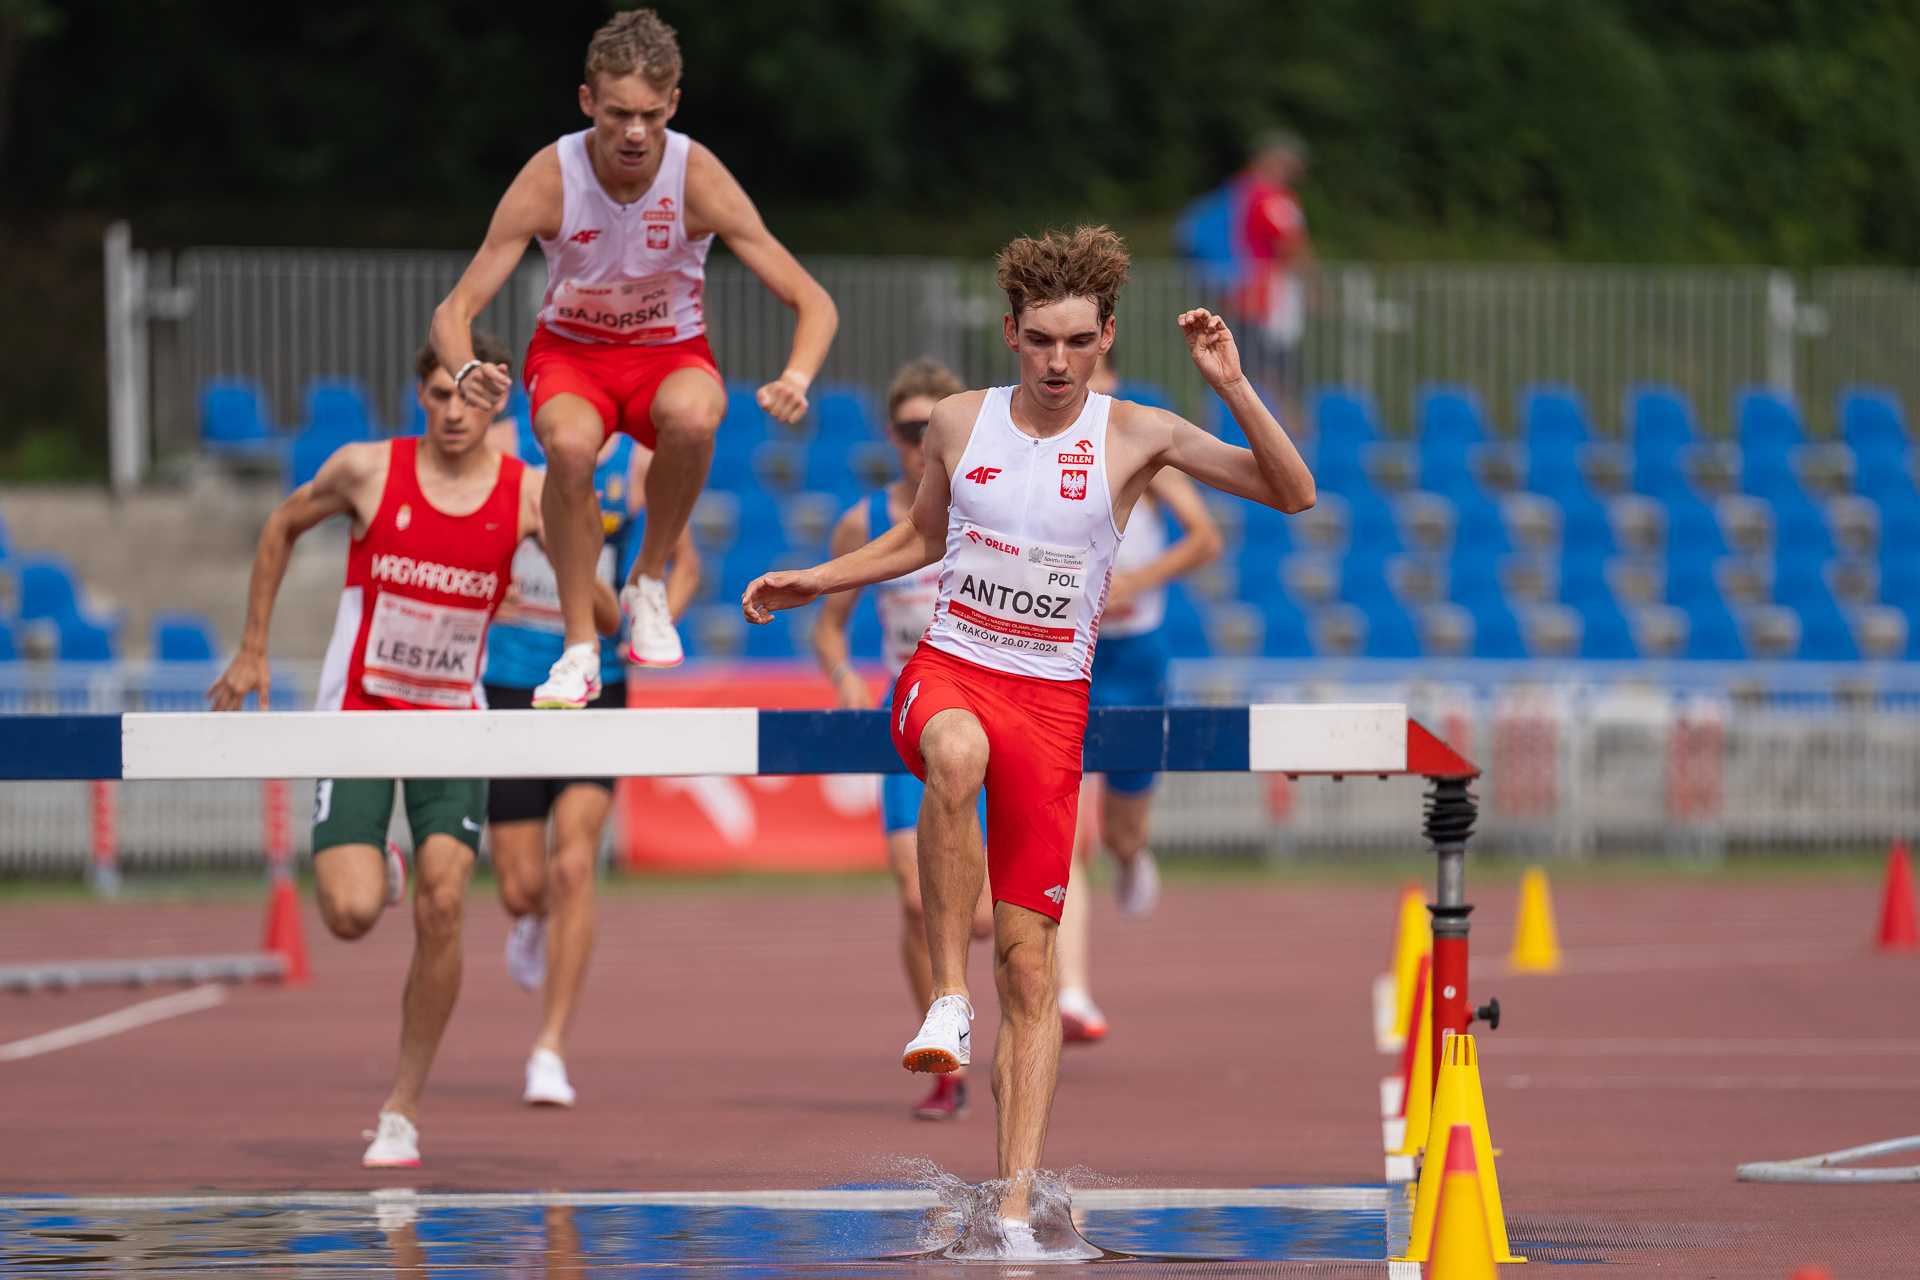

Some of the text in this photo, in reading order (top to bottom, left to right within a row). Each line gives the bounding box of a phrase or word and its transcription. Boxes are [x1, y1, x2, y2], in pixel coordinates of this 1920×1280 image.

[569, 229, 602, 245] 4F
[642, 288, 669, 303] POL
[558, 301, 669, 330] BAJORSKI
[1060, 455, 1093, 464] ORLEN
[965, 466, 1003, 485] 4F
[985, 537, 1020, 557] ORLEN
[1044, 556, 1061, 564] Sportu
[1063, 558, 1083, 566] Turystyki
[371, 553, 499, 602] MAGYARORSZÁ
[1048, 572, 1080, 589] POL
[959, 574, 1072, 620] ANTOSZ
[956, 621, 1058, 653] KRAKÓW 20.07.2024
[376, 637, 467, 672] LESTÁK
[1043, 884, 1066, 905] 4F
